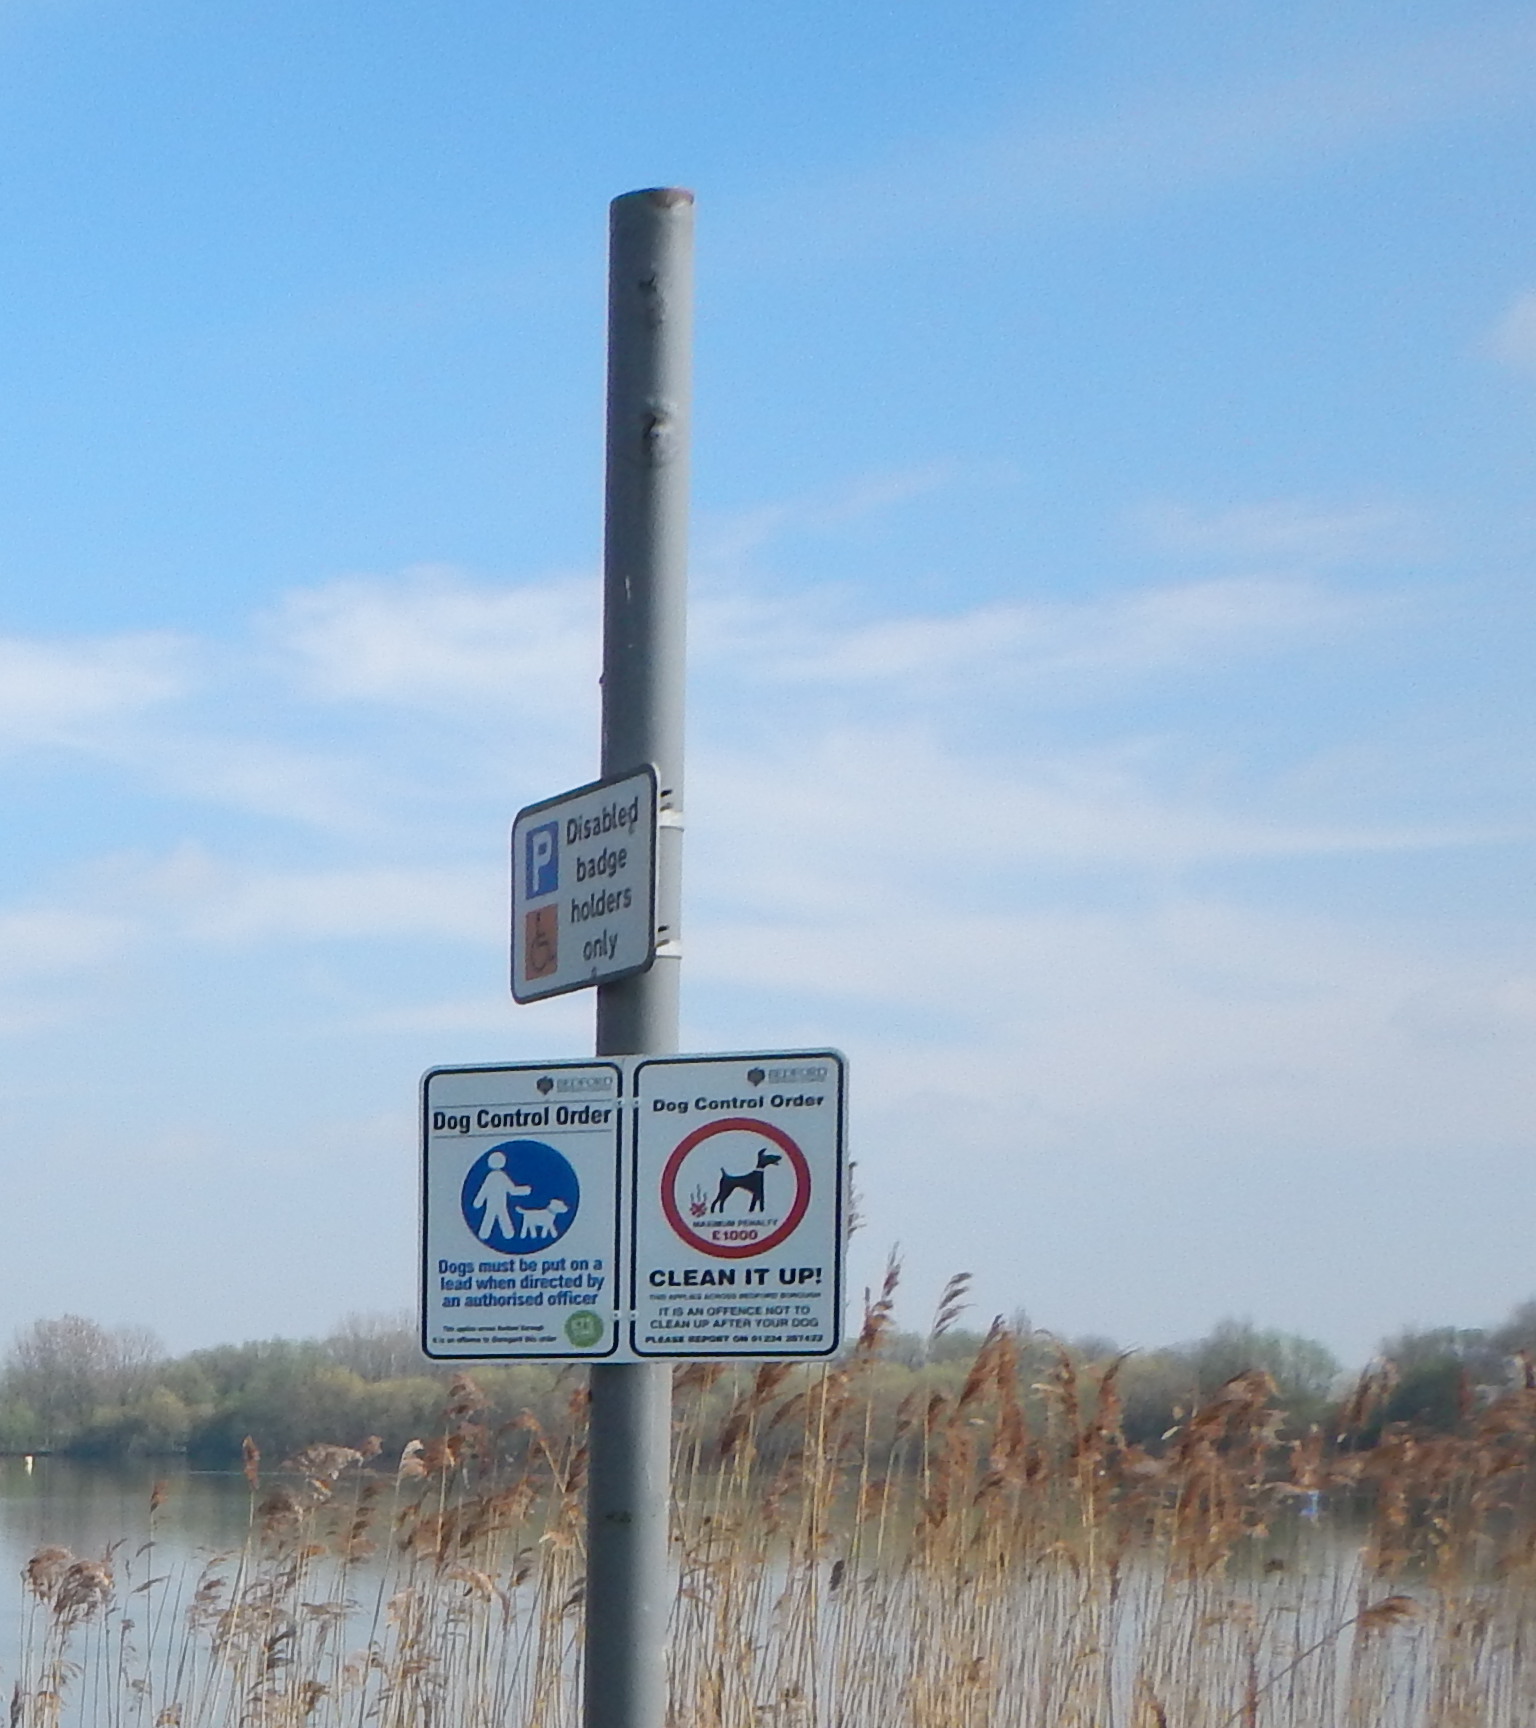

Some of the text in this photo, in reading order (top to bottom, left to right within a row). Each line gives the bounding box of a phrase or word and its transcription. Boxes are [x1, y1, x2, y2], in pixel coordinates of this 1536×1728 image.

[567, 796, 639, 845] Disabled
[532, 830, 552, 893] P
[577, 846, 627, 882] badge
[571, 886, 632, 924] holders
[583, 930, 618, 960] only
[653, 1095, 824, 1113] Dog Control Order
[434, 1105, 611, 1133] Dog Control Order
[712, 1229, 758, 1241] £1000
[439, 1258, 602, 1276] Dogs must be put on a
[441, 1274, 605, 1290] lead when directed by
[649, 1268, 822, 1286] CLEAN IT UP!
[442, 1291, 598, 1307] an authorised officer
[659, 1306, 810, 1316] IT IS AN OFFENCE NOT TO
[650, 1318, 819, 1329] CLEAN UP AFTER YOUR DOG
